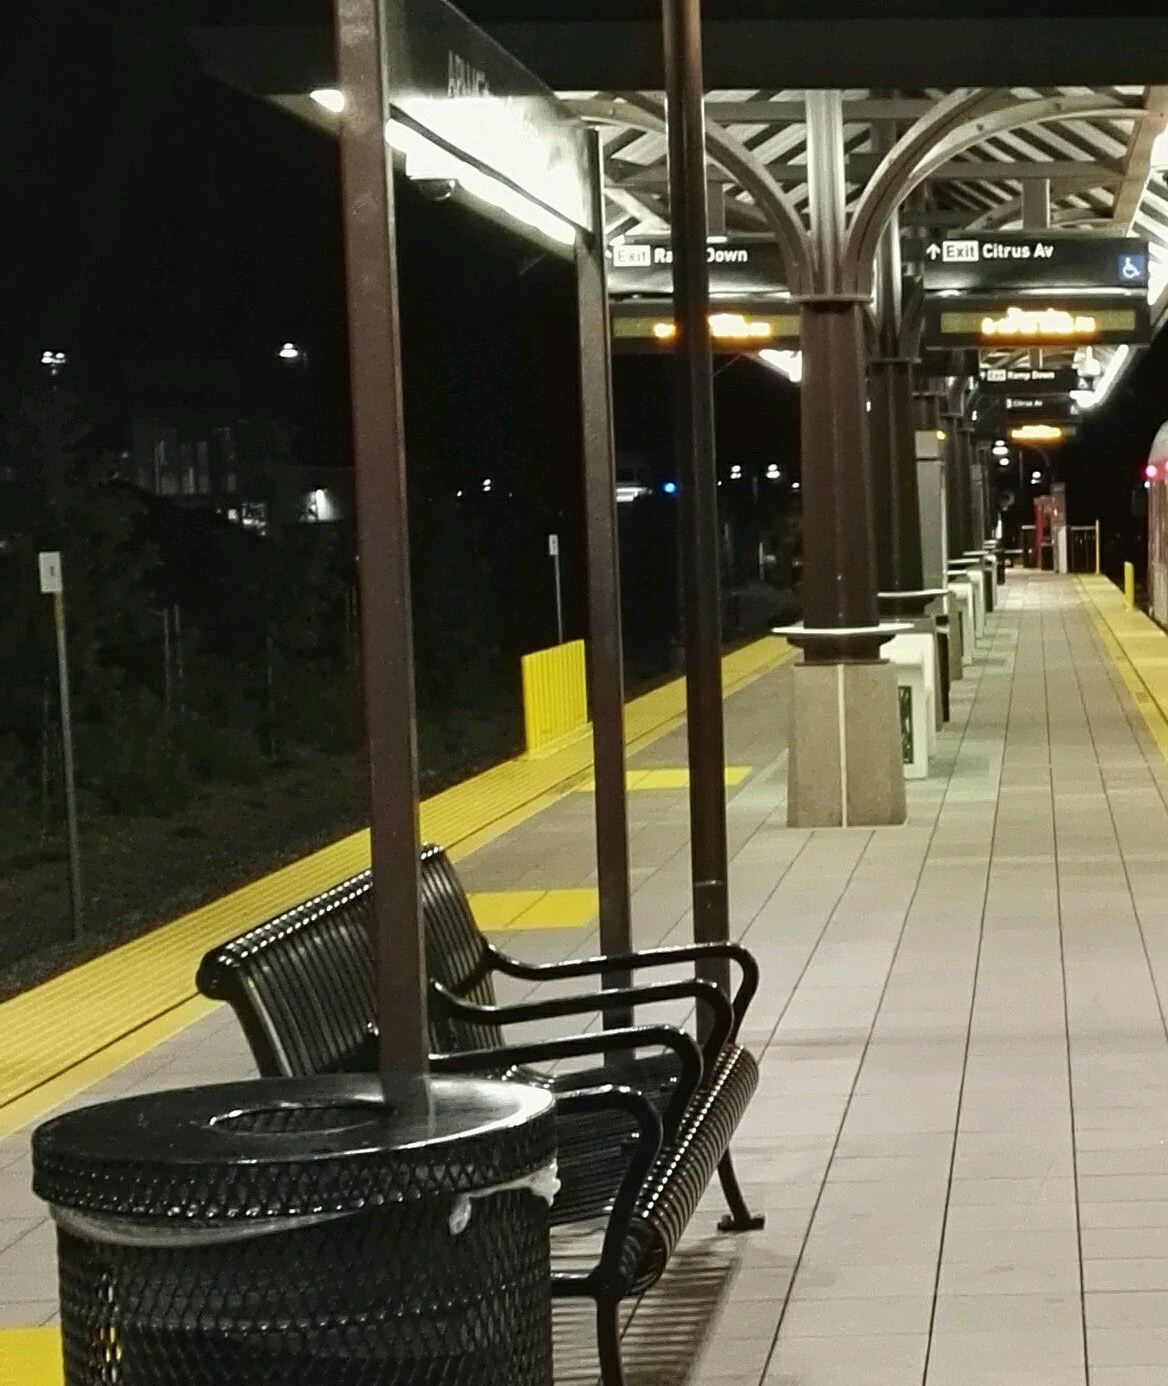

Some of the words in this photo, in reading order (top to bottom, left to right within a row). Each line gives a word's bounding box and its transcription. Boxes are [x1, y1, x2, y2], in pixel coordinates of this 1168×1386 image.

[617, 249, 648, 263] Exit
[945, 244, 976, 258] Exit
[982, 243, 1031, 259] Citrus
[1034, 243, 1054, 258] Av
